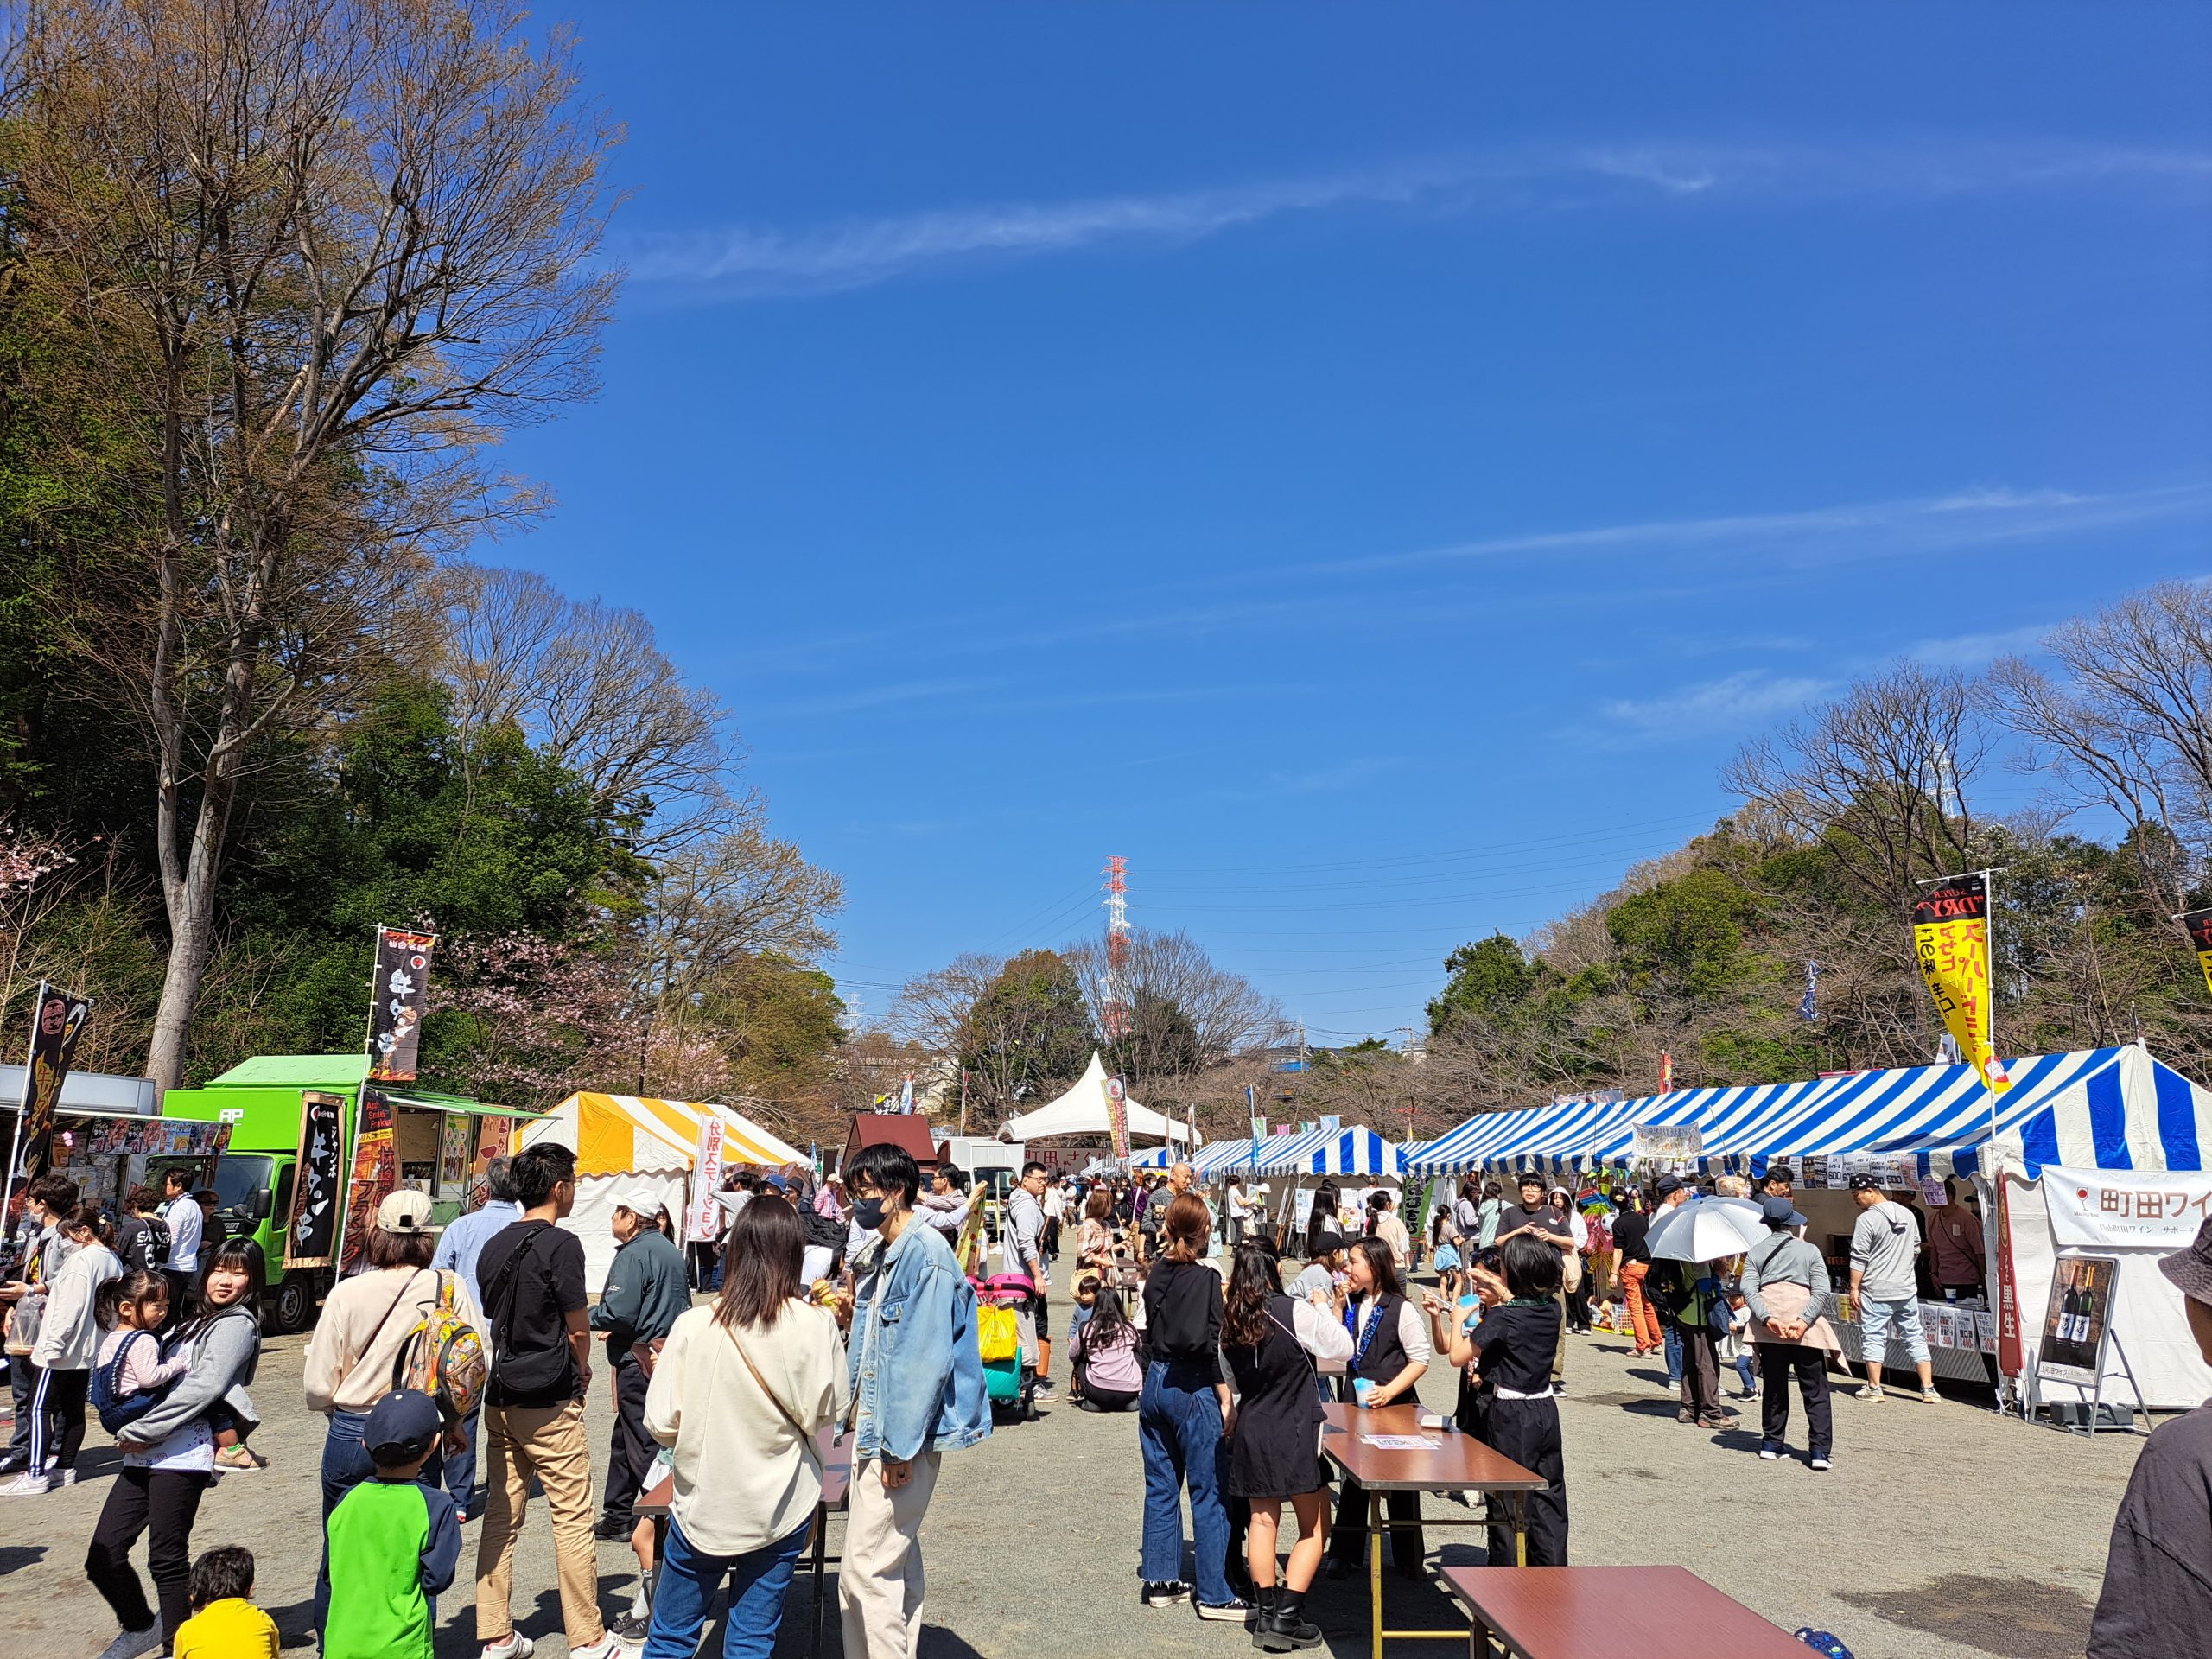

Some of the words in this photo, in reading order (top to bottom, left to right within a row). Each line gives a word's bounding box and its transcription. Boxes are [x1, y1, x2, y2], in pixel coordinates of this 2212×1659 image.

[327, 1125, 338, 1178] ジャンボ
[1886, 1175, 1903, 1185] 500
[2002, 1284, 2017, 1339] 黒生
